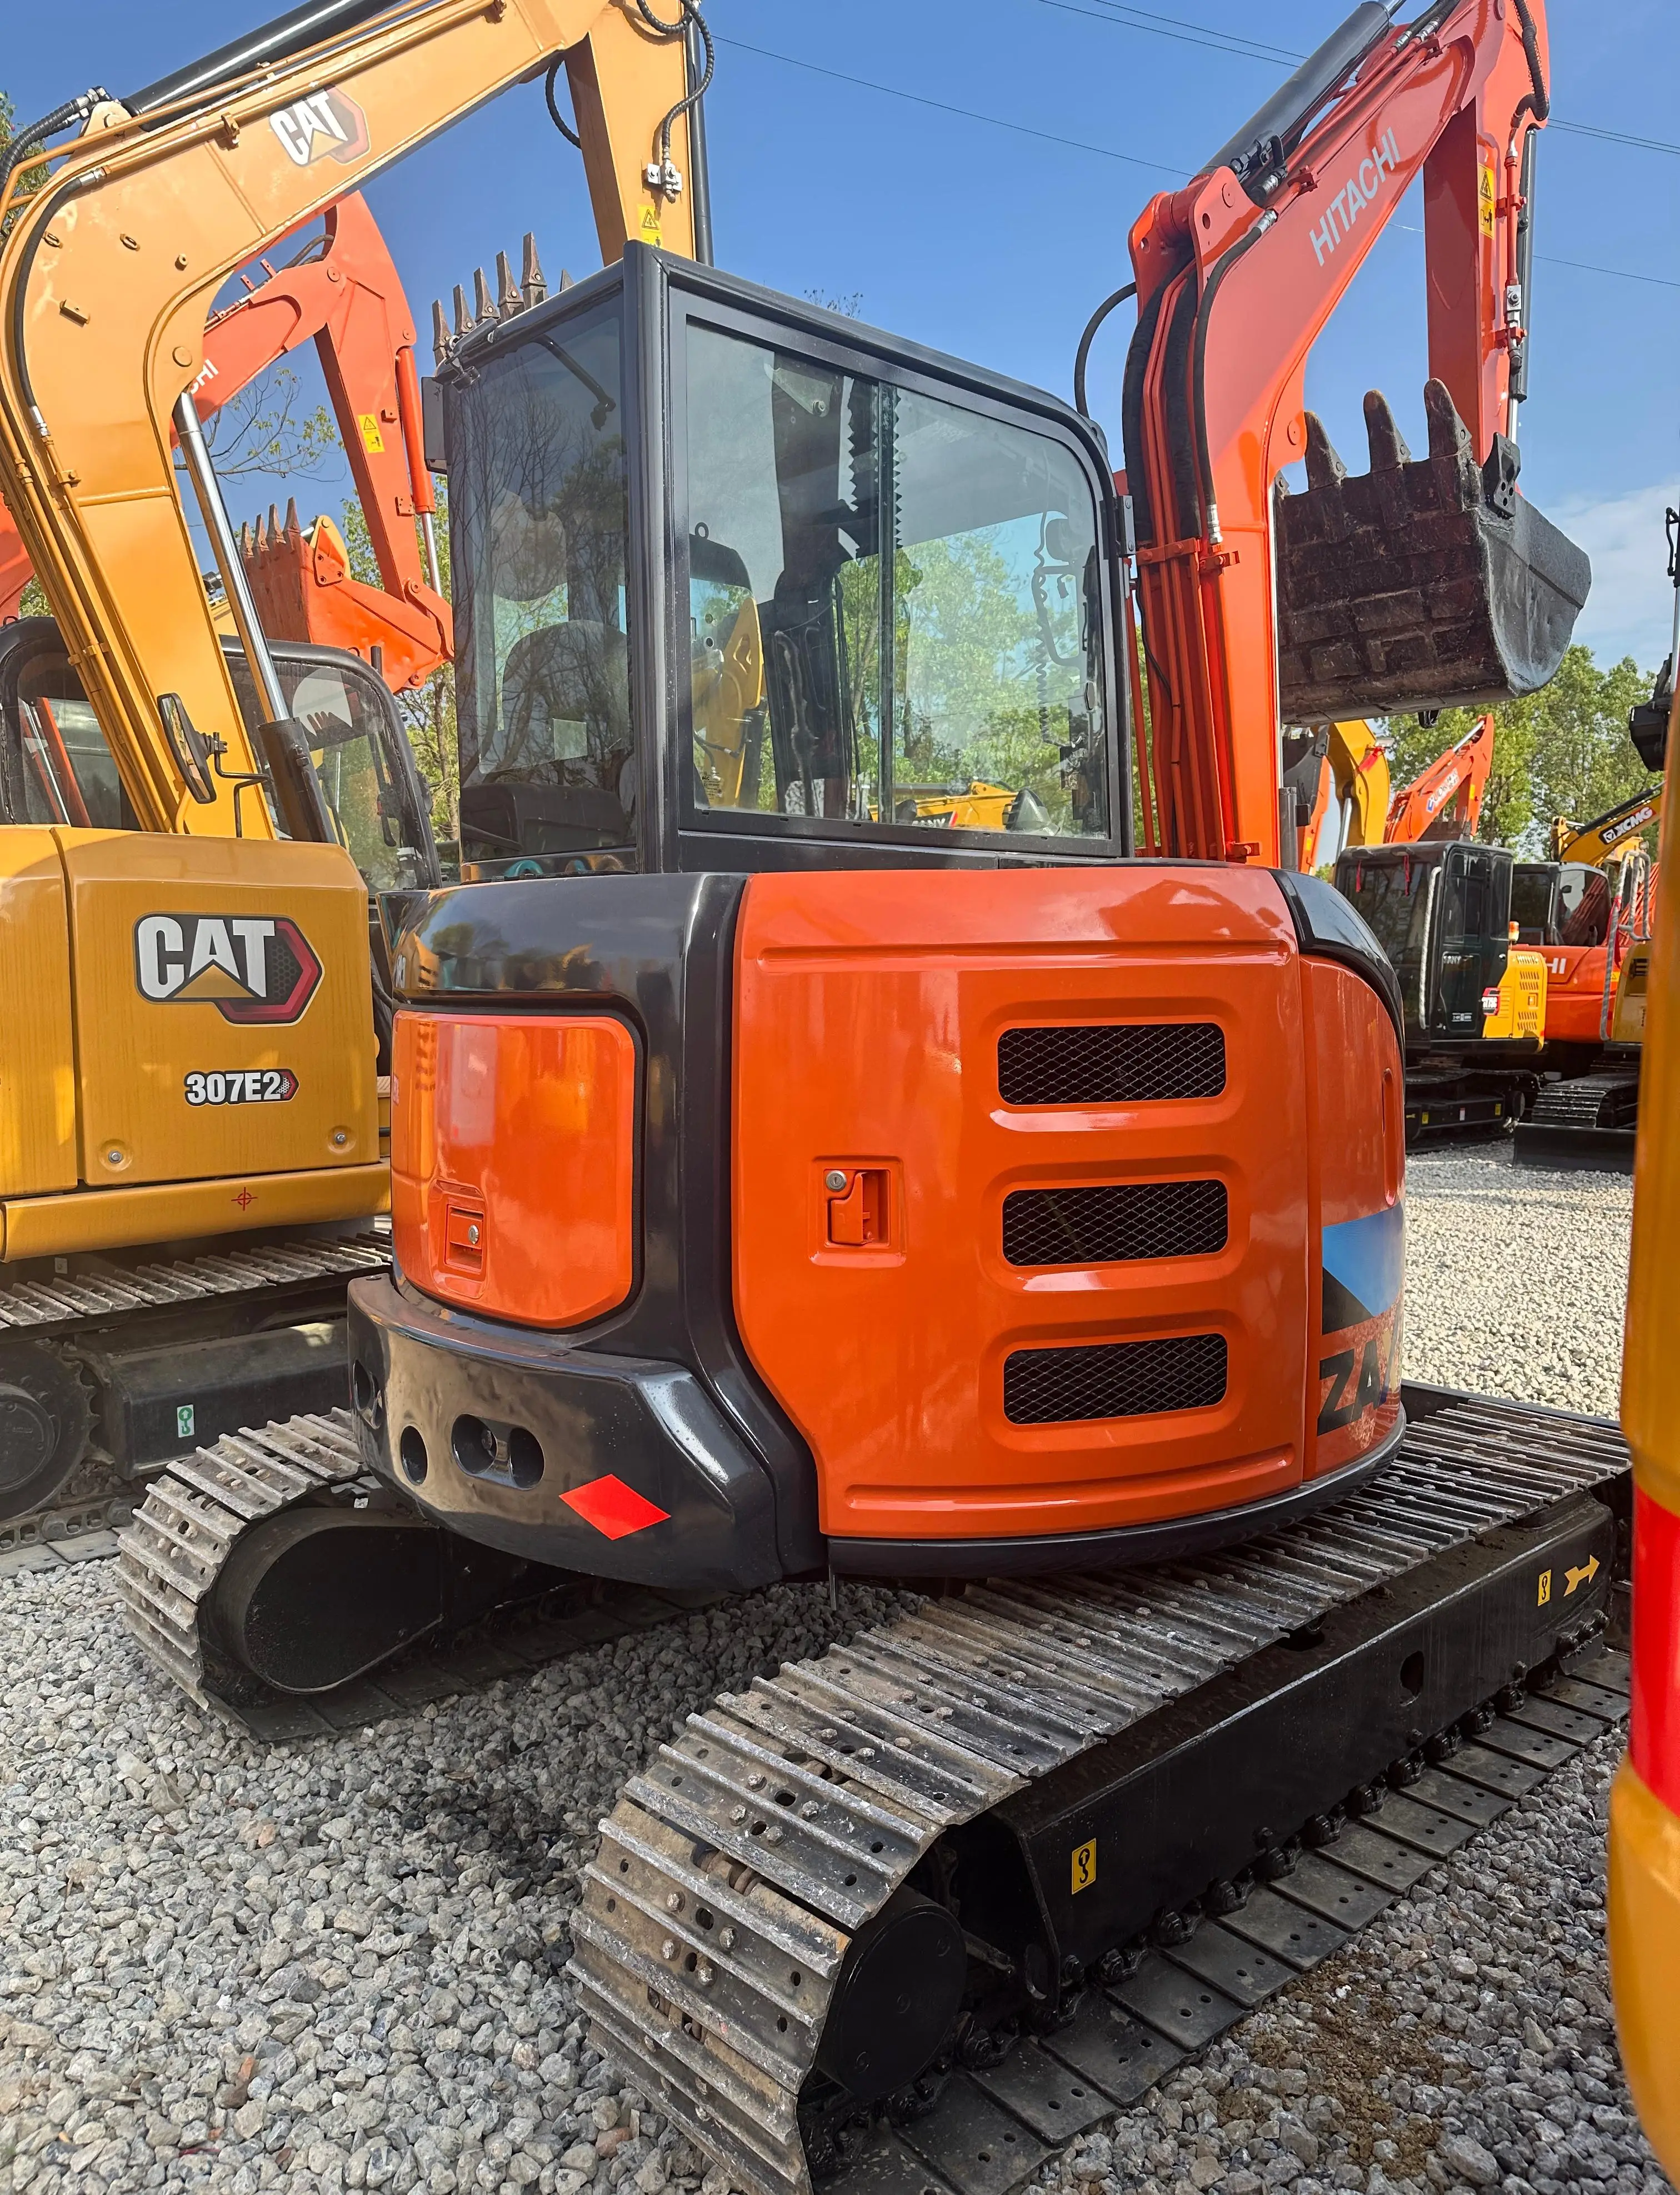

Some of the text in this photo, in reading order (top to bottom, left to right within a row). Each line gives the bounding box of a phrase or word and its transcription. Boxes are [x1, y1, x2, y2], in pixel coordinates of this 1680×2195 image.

[269, 90, 348, 165] CAT
[1309, 126, 1401, 267] HITACHI
[1613, 806, 1653, 838] XCMG
[137, 916, 276, 998] CAT
[186, 1071, 282, 1104] 307E2
